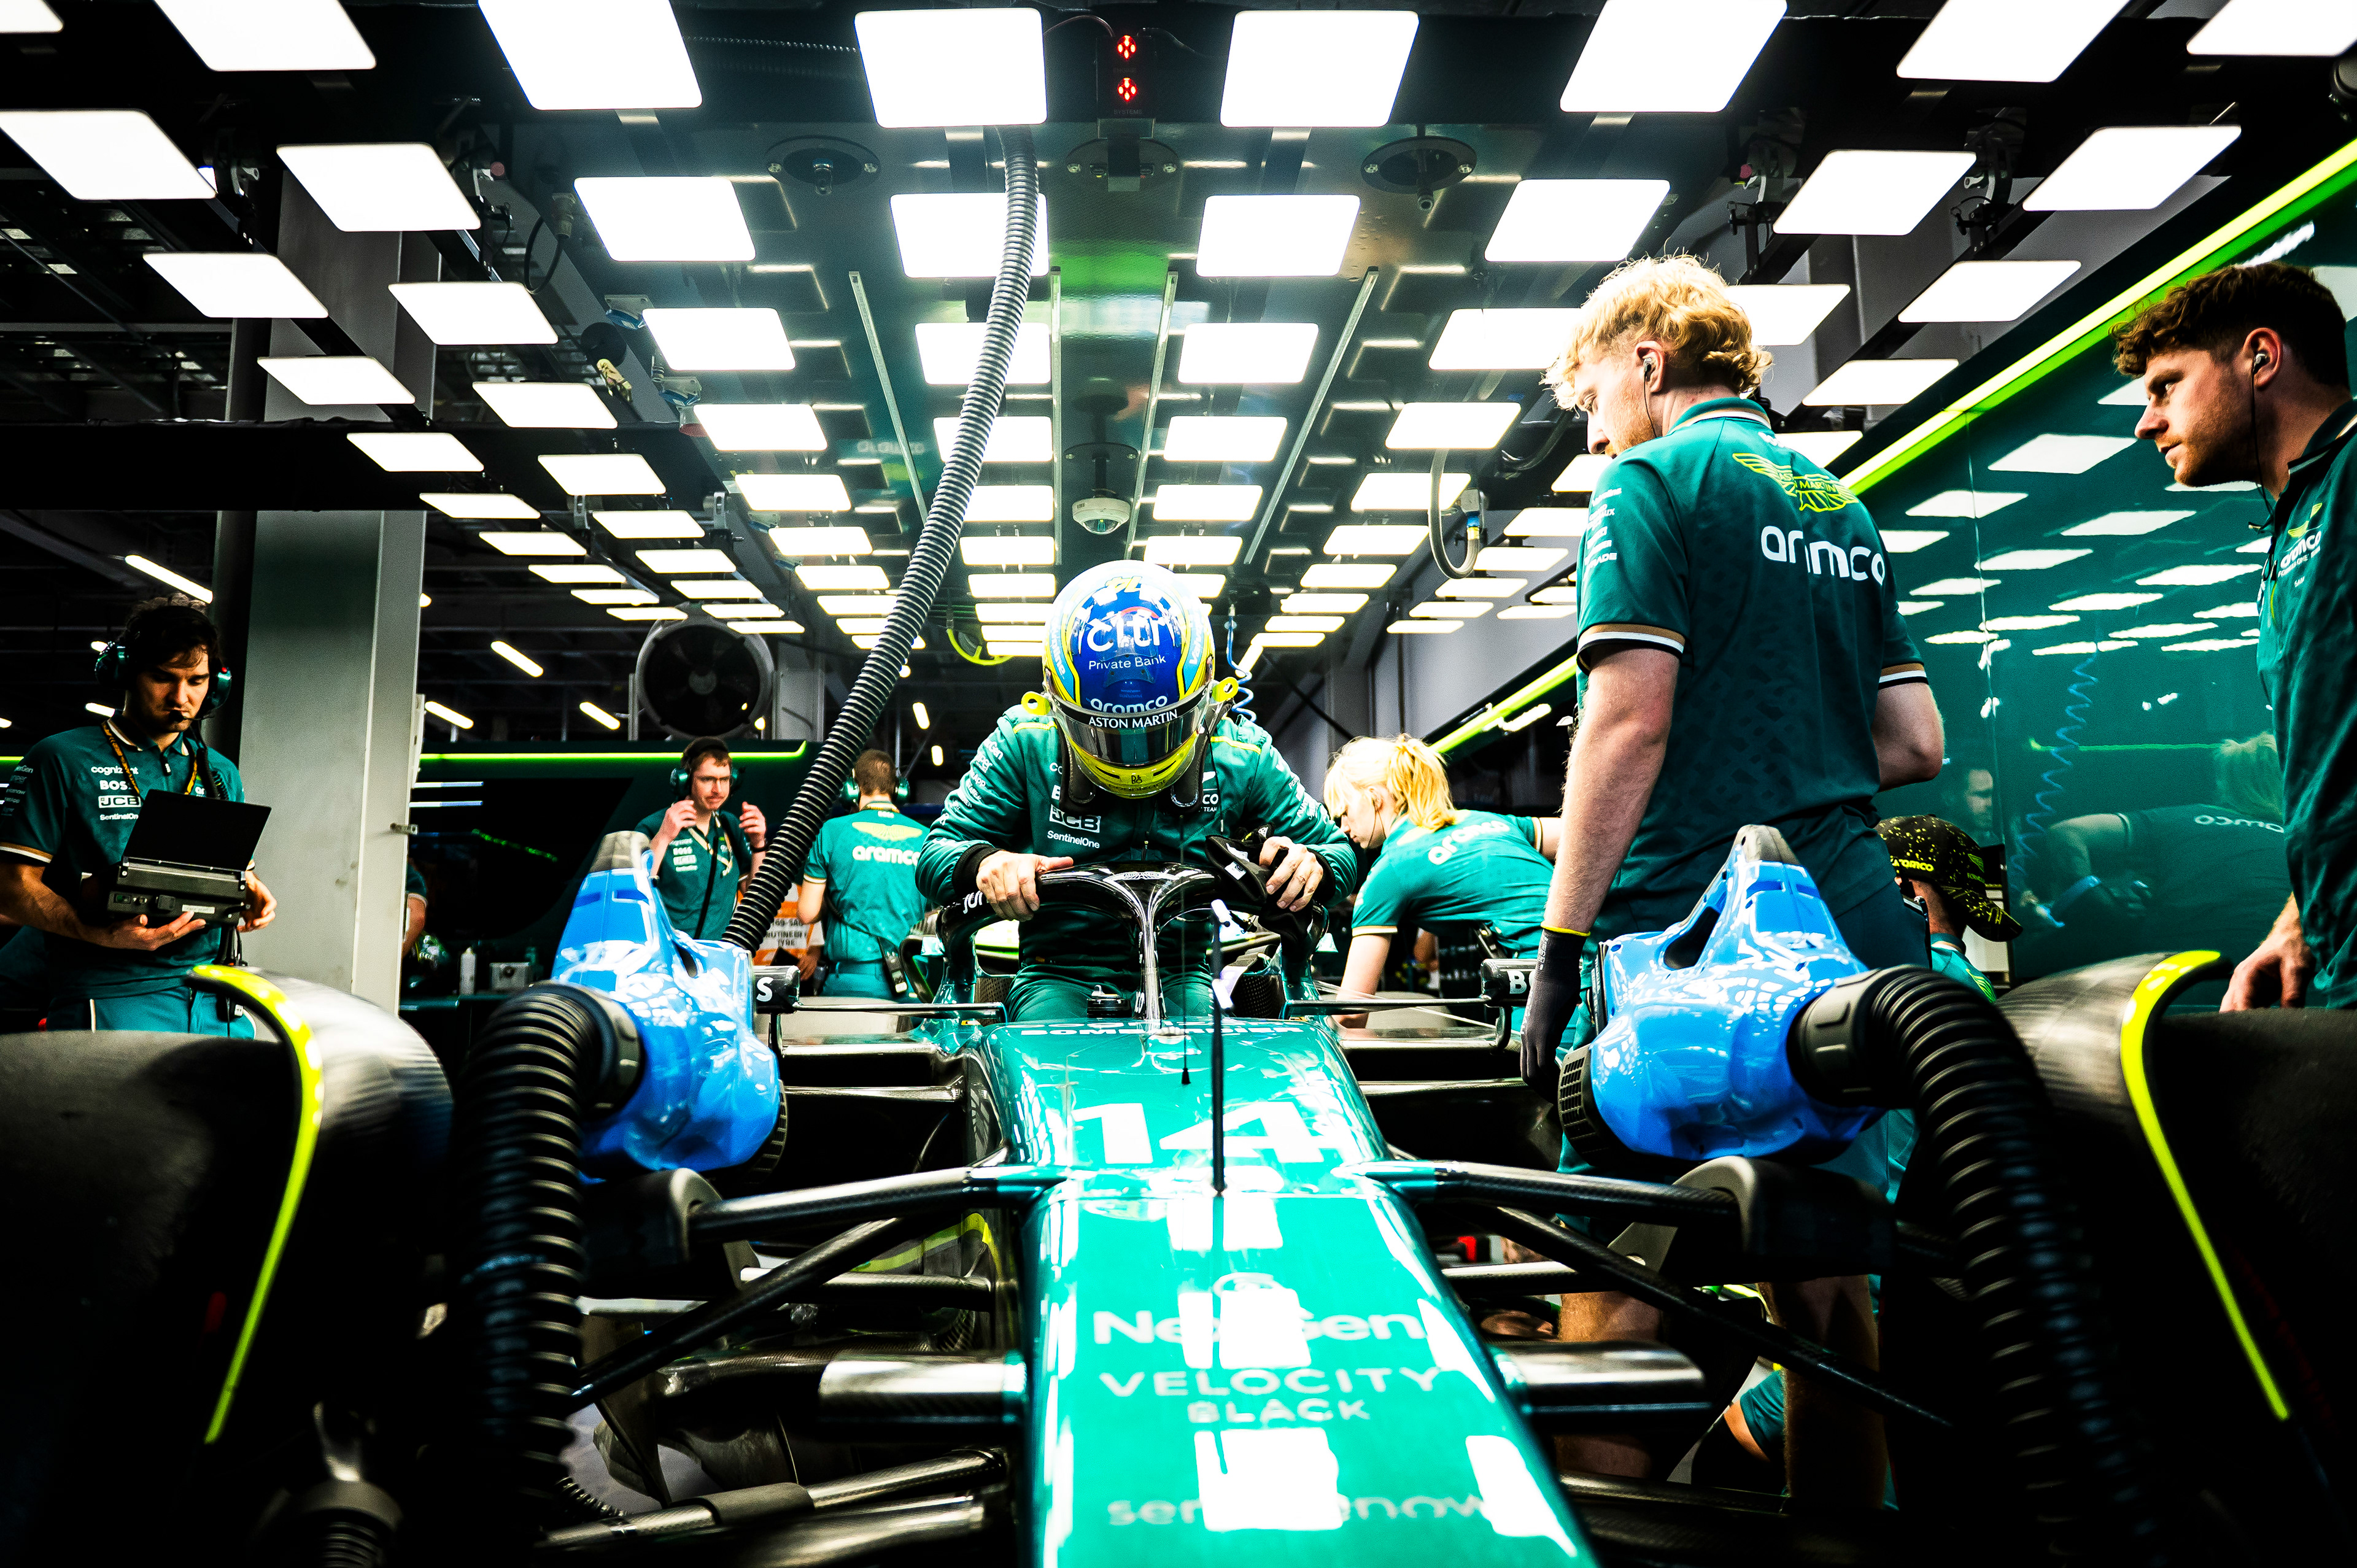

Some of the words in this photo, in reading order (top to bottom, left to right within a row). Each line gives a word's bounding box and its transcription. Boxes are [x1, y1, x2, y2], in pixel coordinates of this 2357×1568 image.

[1799, 480, 1837, 492] MARTIN
[1760, 525, 1886, 586] armco
[1088, 658, 1131, 670] Private
[1135, 654, 1166, 667] Bank
[1088, 716, 1128, 728] ASTON
[1132, 709, 1178, 728] MARTIN
[91, 765, 139, 776] cogniznt
[99, 780, 133, 790] BOS
[99, 796, 141, 808] JCB
[1051, 806, 1101, 832] JCB
[1047, 830, 1101, 849] SentinelOne
[1072, 1102, 1333, 1164] 14
[1093, 1310, 1428, 1344] Neen
[1099, 1367, 1441, 1397] VELOCITY
[1187, 1398, 1371, 1424] BLACK
[1107, 1493, 1490, 1526] sernow
